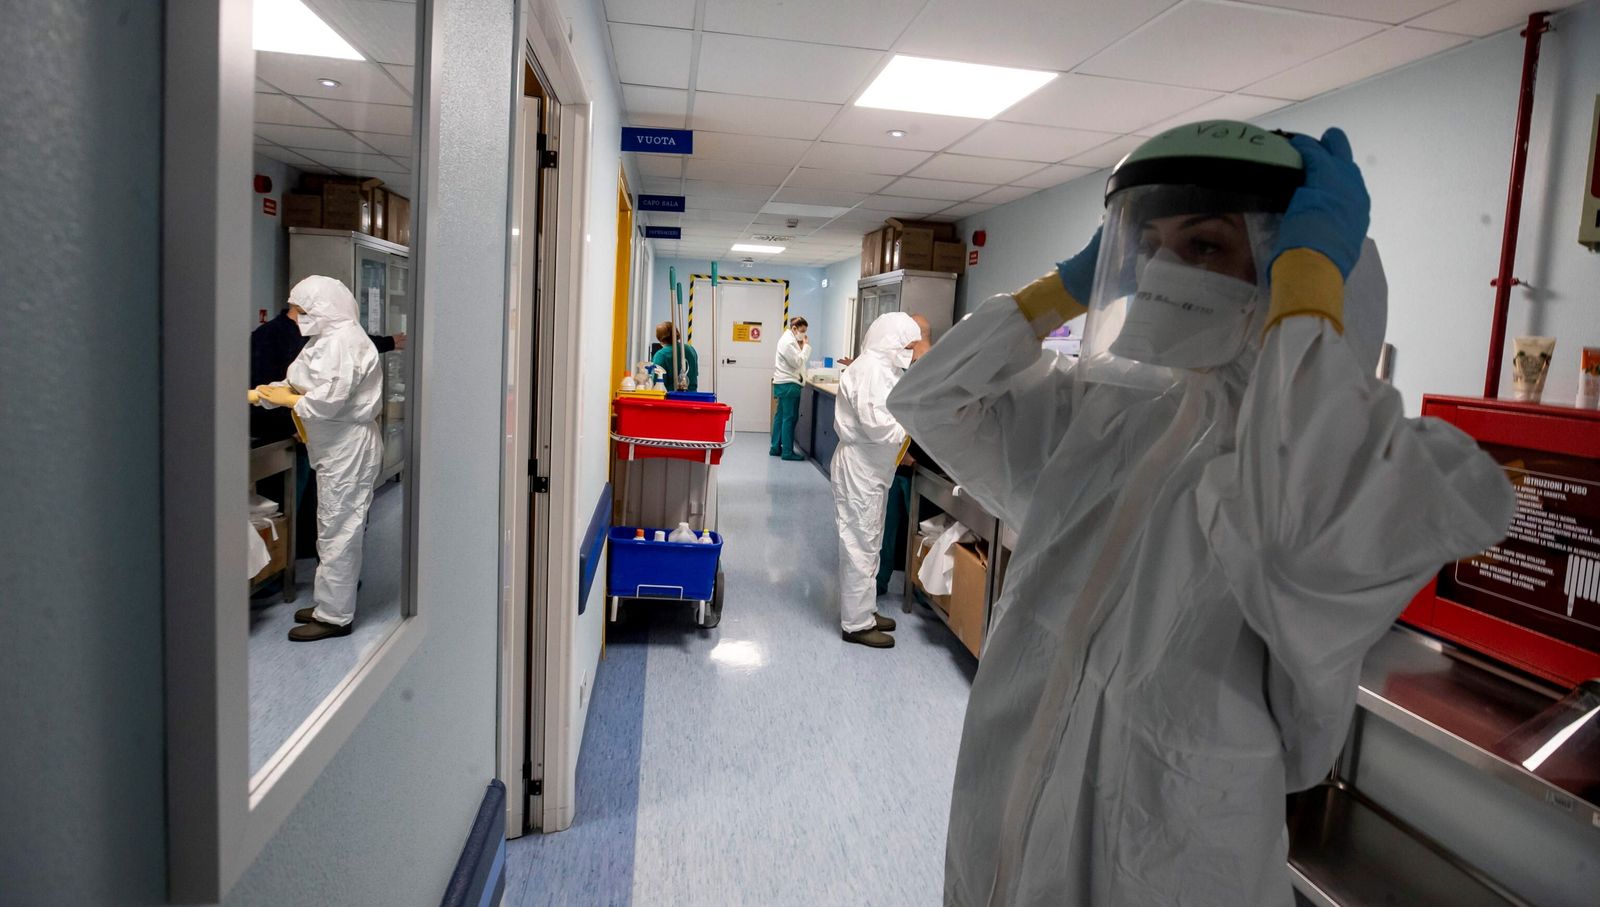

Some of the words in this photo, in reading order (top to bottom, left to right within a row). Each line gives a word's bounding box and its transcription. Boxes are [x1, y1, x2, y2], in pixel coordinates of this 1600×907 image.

[637, 135, 676, 146] VUOTA
[642, 199, 660, 207] CAPO
[1524, 476, 1563, 491] ISTRUZIONI
[1564, 483, 1588, 496] D'USO
[1547, 541, 1567, 551] VALVOLA
